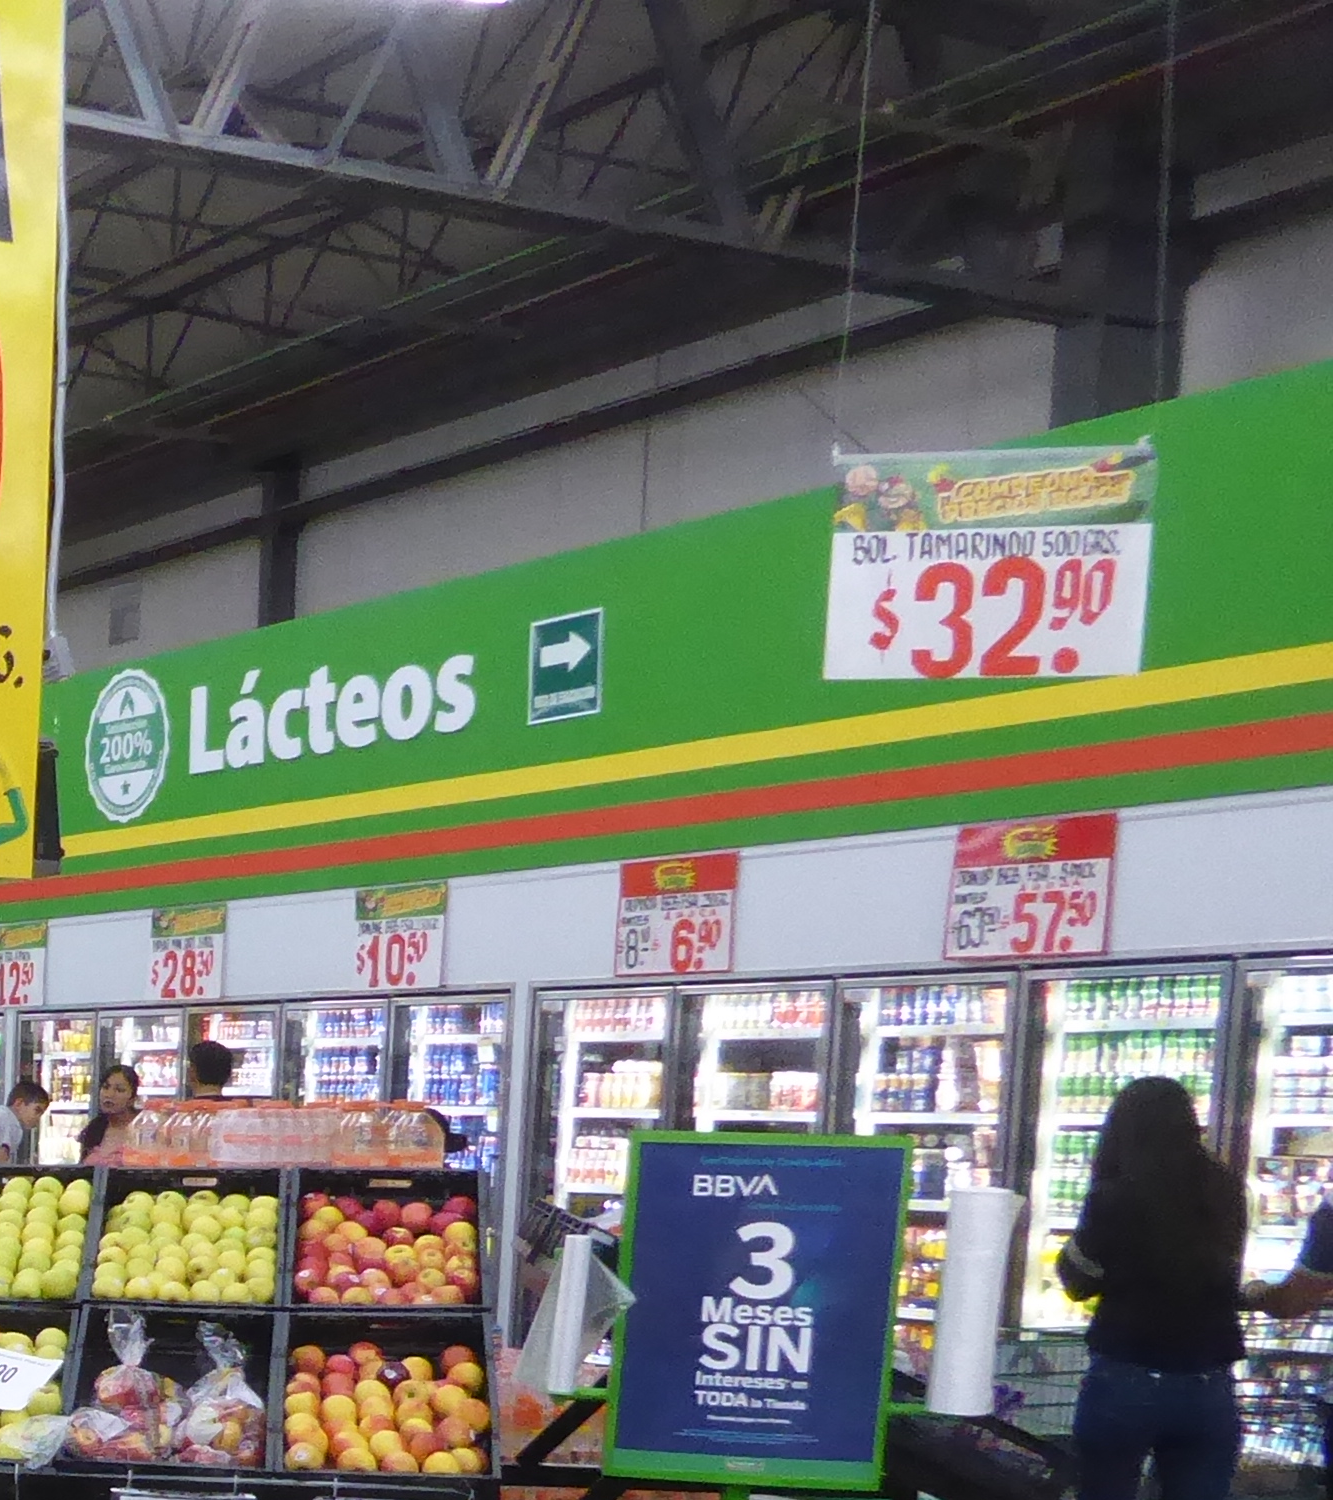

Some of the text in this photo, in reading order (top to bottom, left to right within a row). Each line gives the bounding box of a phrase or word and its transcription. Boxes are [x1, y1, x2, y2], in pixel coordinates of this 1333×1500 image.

[905, 531, 1036, 561] TAMARINDO
[188, 655, 476, 775] Lácteos
[100, 729, 152, 764] 200%
[693, 1174, 778, 1197] BBVA
[729, 1221, 796, 1301] 3
[701, 1296, 814, 1326] Meses
[699, 1324, 813, 1373] SIN
[694, 1390, 749, 1407] TODA
